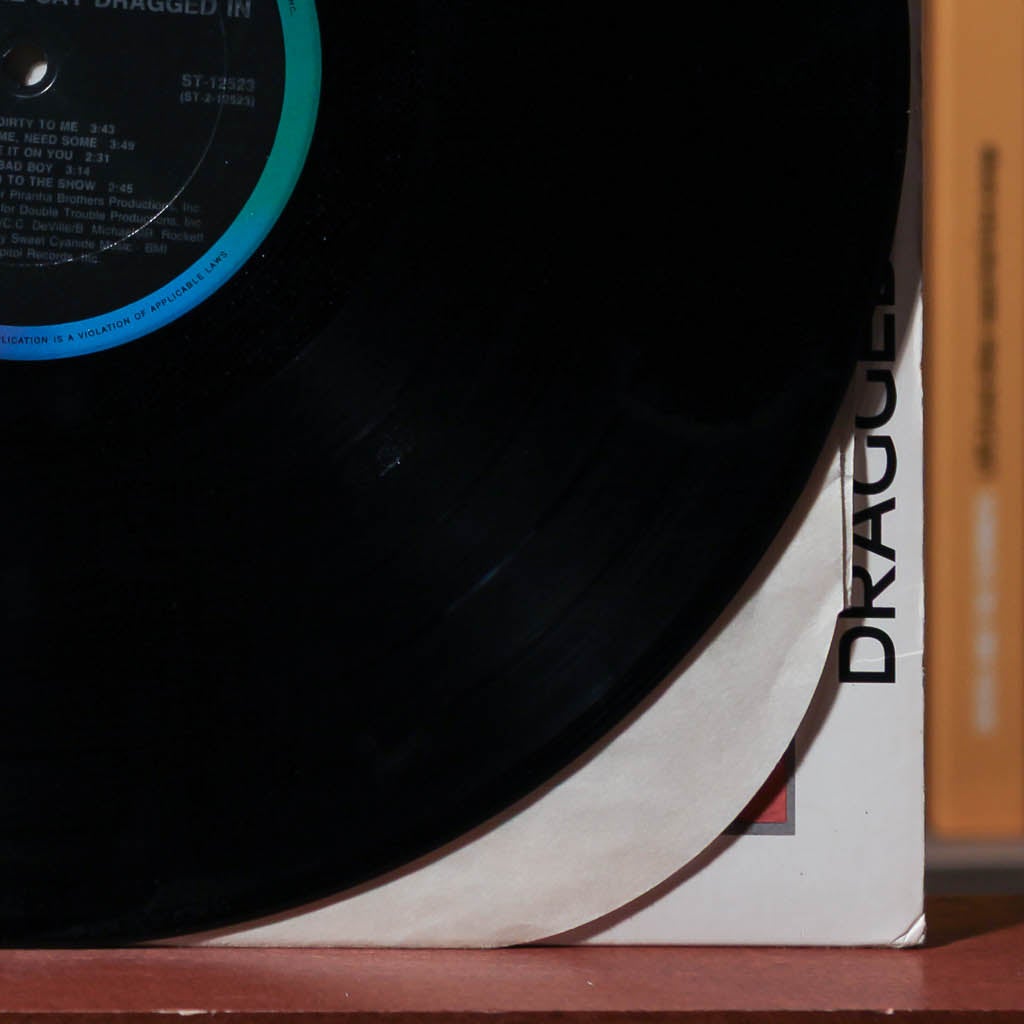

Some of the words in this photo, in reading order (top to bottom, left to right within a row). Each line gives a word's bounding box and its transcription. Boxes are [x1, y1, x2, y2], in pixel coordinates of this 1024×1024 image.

[39, 119, 56, 131] TO
[59, 120, 79, 133] ME
[89, 122, 116, 135] 3:43
[24, 132, 58, 145] NEED
[62, 136, 97, 149] SOME
[8, 146, 19, 157] IT
[24, 147, 42, 159] ON
[47, 149, 73, 161] YOU
[85, 152, 111, 164] 2:31
[27, 162, 53, 175] BOY
[65, 165, 91, 177] 3:14
[7, 175, 25, 187] TO
[29, 176, 54, 188] THE
[57, 178, 97, 191] SHOW
[56, 193, 104, 207] Brothers
[0, 201, 14, 213] for
[19, 203, 59, 218] Double
[64, 206, 106, 221] Trouble
[52, 333, 63, 343] IS
[66, 332, 74, 341] A
[76, 316, 131, 339] VIOLATION
[132, 308, 146, 320] OF
[147, 271, 205, 313] APPLICABLE
